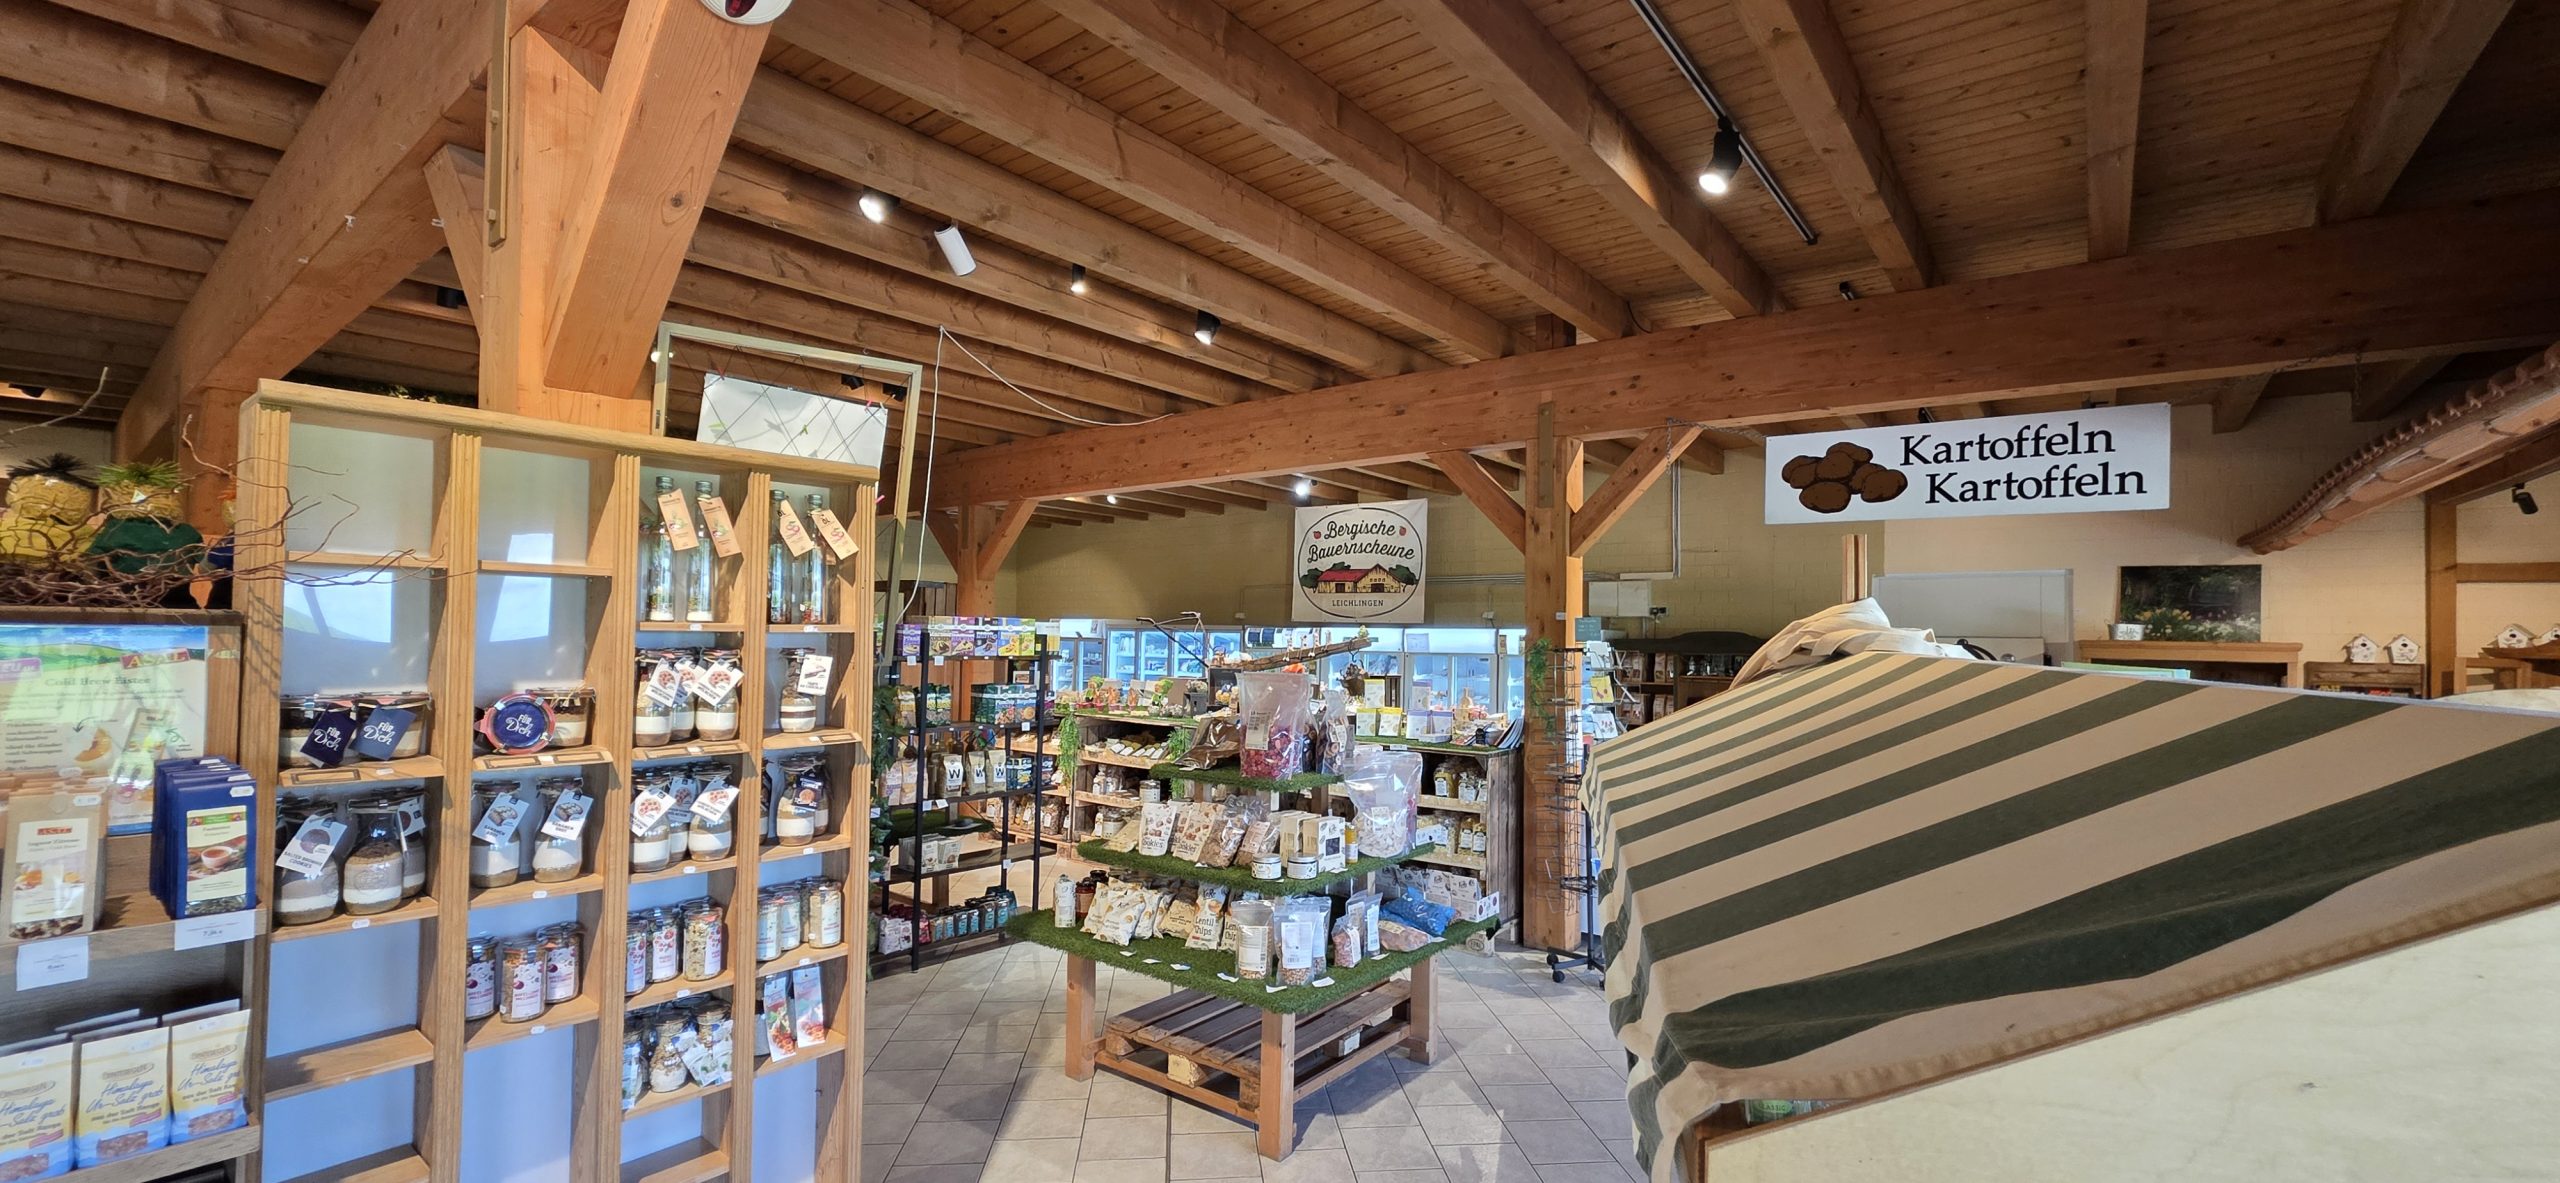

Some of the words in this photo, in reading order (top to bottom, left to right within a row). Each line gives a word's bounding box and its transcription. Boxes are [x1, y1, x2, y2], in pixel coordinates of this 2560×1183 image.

[1901, 421, 2116, 467] Kartoffeln
[1925, 461, 2148, 504] Kartoffeln
[1324, 519, 1397, 541] Bergische
[1307, 539, 1416, 564] Bauernscheune
[1331, 600, 1385, 608] LEICHLINGEN
[518, 714, 532, 725] FÜR
[327, 726, 341, 739] FÜR
[378, 721, 394, 733] FÜR
[505, 716, 534, 737] Dich
[314, 728, 342, 751] Dich
[363, 724, 396, 745] Dich
[948, 768, 960, 780] W
[995, 767, 1005, 778] W
[1142, 840, 1164, 848] ookies
[1195, 914, 1215, 927] Lentil
[1194, 924, 1213, 937] Chips
[191, 1058, 238, 1077] Himalaya
[101, 1077, 155, 1098] Himalaya
[1758, 1101, 1787, 1112] CLASSIC
